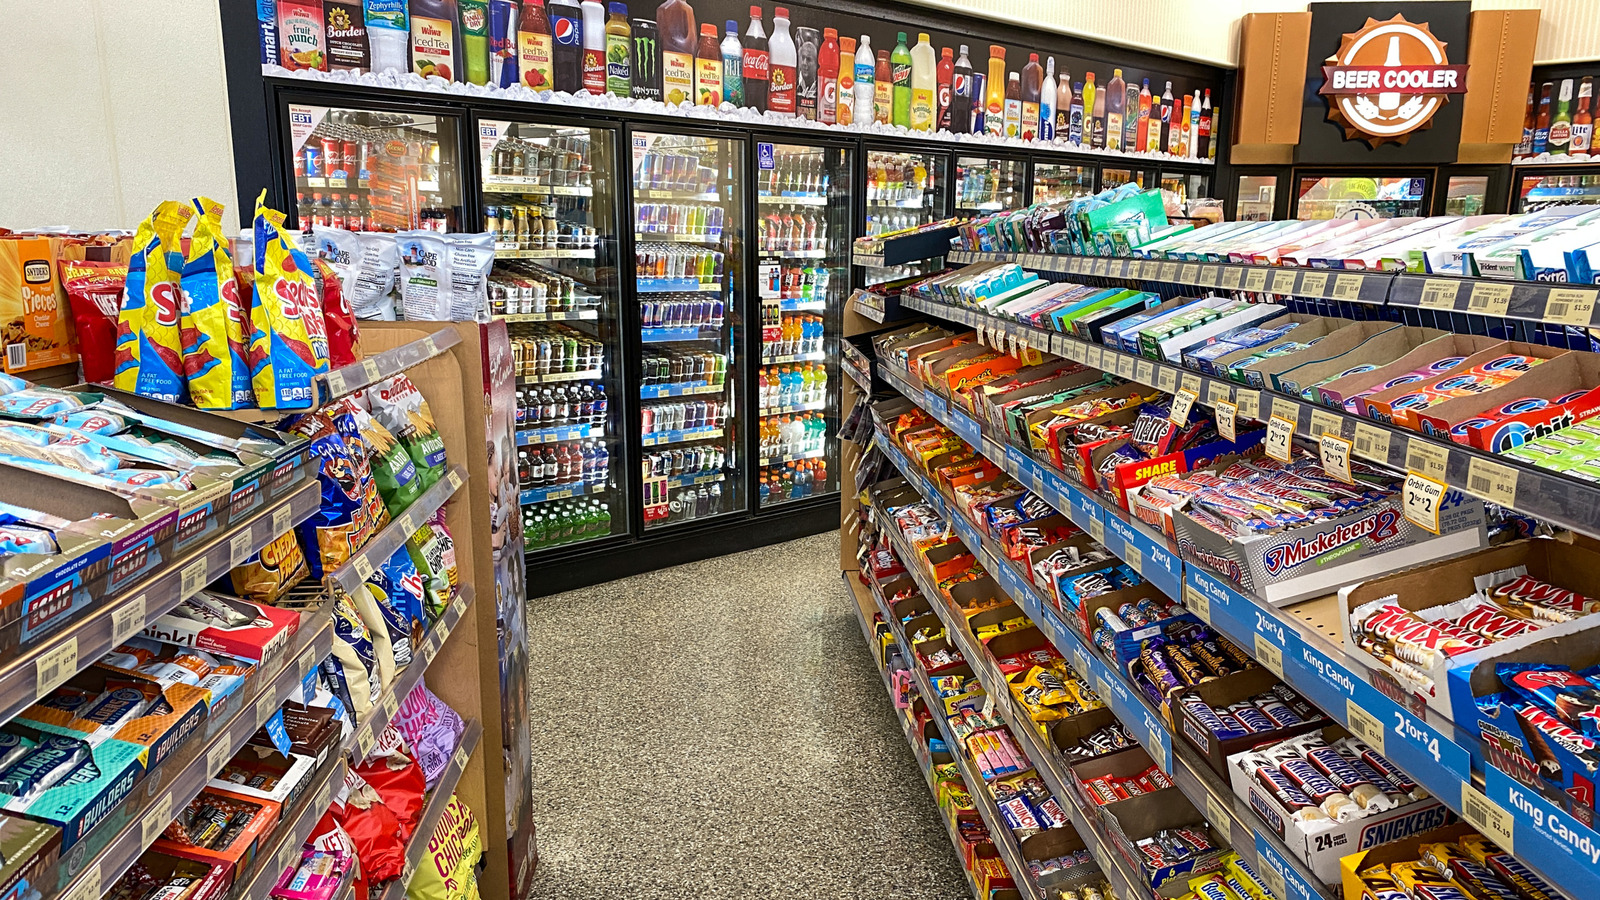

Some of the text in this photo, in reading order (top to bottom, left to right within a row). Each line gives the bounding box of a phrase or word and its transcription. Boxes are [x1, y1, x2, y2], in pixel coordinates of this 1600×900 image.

[293, 25, 311, 35] fruit
[327, 25, 365, 38] Borden
[421, 25, 442, 36] Wawa
[288, 34, 318, 47] punch
[414, 36, 449, 49] Iced Tea
[771, 82, 793, 92] Borden
[1332, 70, 1457, 89] BEER COOLER
[292, 114, 312, 123] EBT
[482, 128, 497, 136] EBT
[1572, 126, 1588, 136] Lite
[634, 138, 647, 147] EBT
[334, 248, 350, 259] CAPE
[419, 250, 438, 261] CAPE
[422, 258, 437, 267] COD
[1480, 262, 1498, 272] Trident
[27, 268, 48, 277] SNYDER'S
[64, 266, 95, 279] GRAB
[22, 286, 57, 315] Pieces
[1574, 304, 1591, 312] $1.59
[380, 379, 417, 400] BOULDER
[1270, 420, 1291, 433] Orbit Gum
[1422, 418, 1451, 441] Orbit
[1491, 406, 1576, 454] Orbit
[1322, 439, 1347, 454] Orbit Gum
[1136, 460, 1177, 481] SHARE
[1430, 462, 1444, 472] $1.59
[1408, 478, 1440, 497] Orbit Gum
[1440, 490, 1464, 512] 24
[1111, 518, 1135, 544] King Candy
[1264, 545, 1284, 576] 3
[1283, 514, 1376, 567] Musketeers
[1378, 512, 1397, 538] 2
[55, 558, 88, 579] CHOCOLATE CHIP
[1195, 572, 1230, 605] King Candy
[1496, 574, 1592, 612] TWIX
[1365, 605, 1447, 651] TWIX
[1303, 648, 1355, 696] King Candy
[138, 733, 152, 743] 12
[1368, 729, 1383, 743] $2.19
[1313, 750, 1363, 784] SNICKERS
[1328, 772, 1343, 788] WHITE
[1386, 772, 1401, 787] WHITE
[1301, 782, 1317, 797] WHITE
[83, 769, 135, 834] BUILDERS
[56, 805, 72, 817] 12
[1008, 799, 1037, 829] CRUNCH
[1042, 800, 1068, 823] CRUNCH
[1250, 790, 1282, 832] SNICKERS
[1362, 806, 1447, 848] SNICKERS
[1492, 821, 1511, 839] $2.19
[1509, 787, 1544, 827] King
[1548, 815, 1600, 865] Candy
[1316, 832, 1347, 853] 24 COUNT
[1334, 838, 1348, 847] PACKS
[1266, 846, 1283, 874] King
[1284, 865, 1311, 900] Candy
